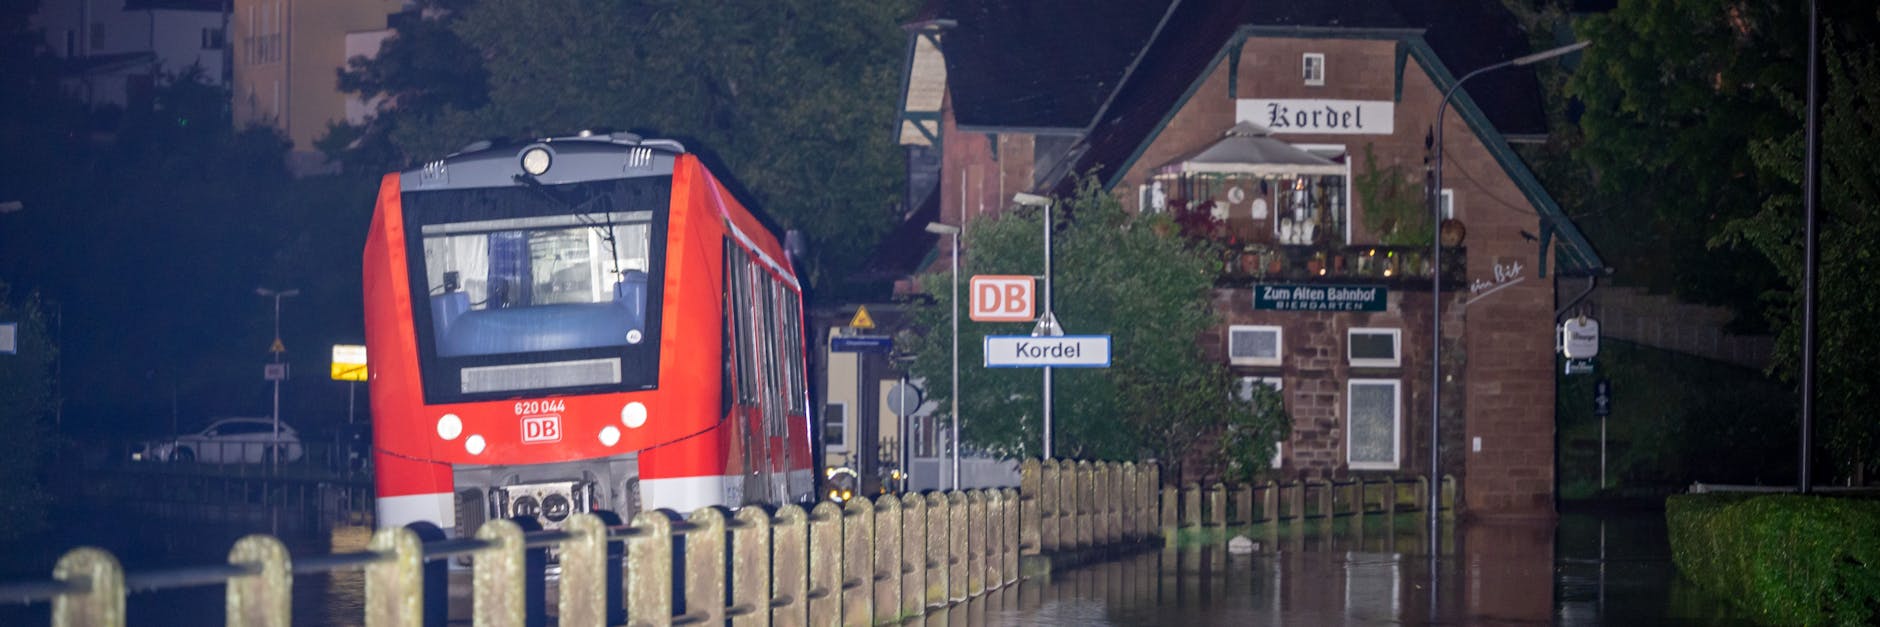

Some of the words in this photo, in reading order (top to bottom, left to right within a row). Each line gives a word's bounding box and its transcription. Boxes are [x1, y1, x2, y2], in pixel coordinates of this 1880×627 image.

[1267, 102, 1363, 129] Kordel
[1494, 260, 1524, 283] Bit
[979, 283, 1027, 313] DB
[1263, 286, 1291, 301] Zum
[1292, 287, 1325, 301] Alten
[1327, 287, 1377, 303] Bahnhof
[1276, 301, 1363, 311] BIERGARTEN
[1015, 341, 1081, 359] Kordel
[514, 401, 539, 416] 620
[541, 399, 566, 414] 044
[527, 420, 556, 438] DB
